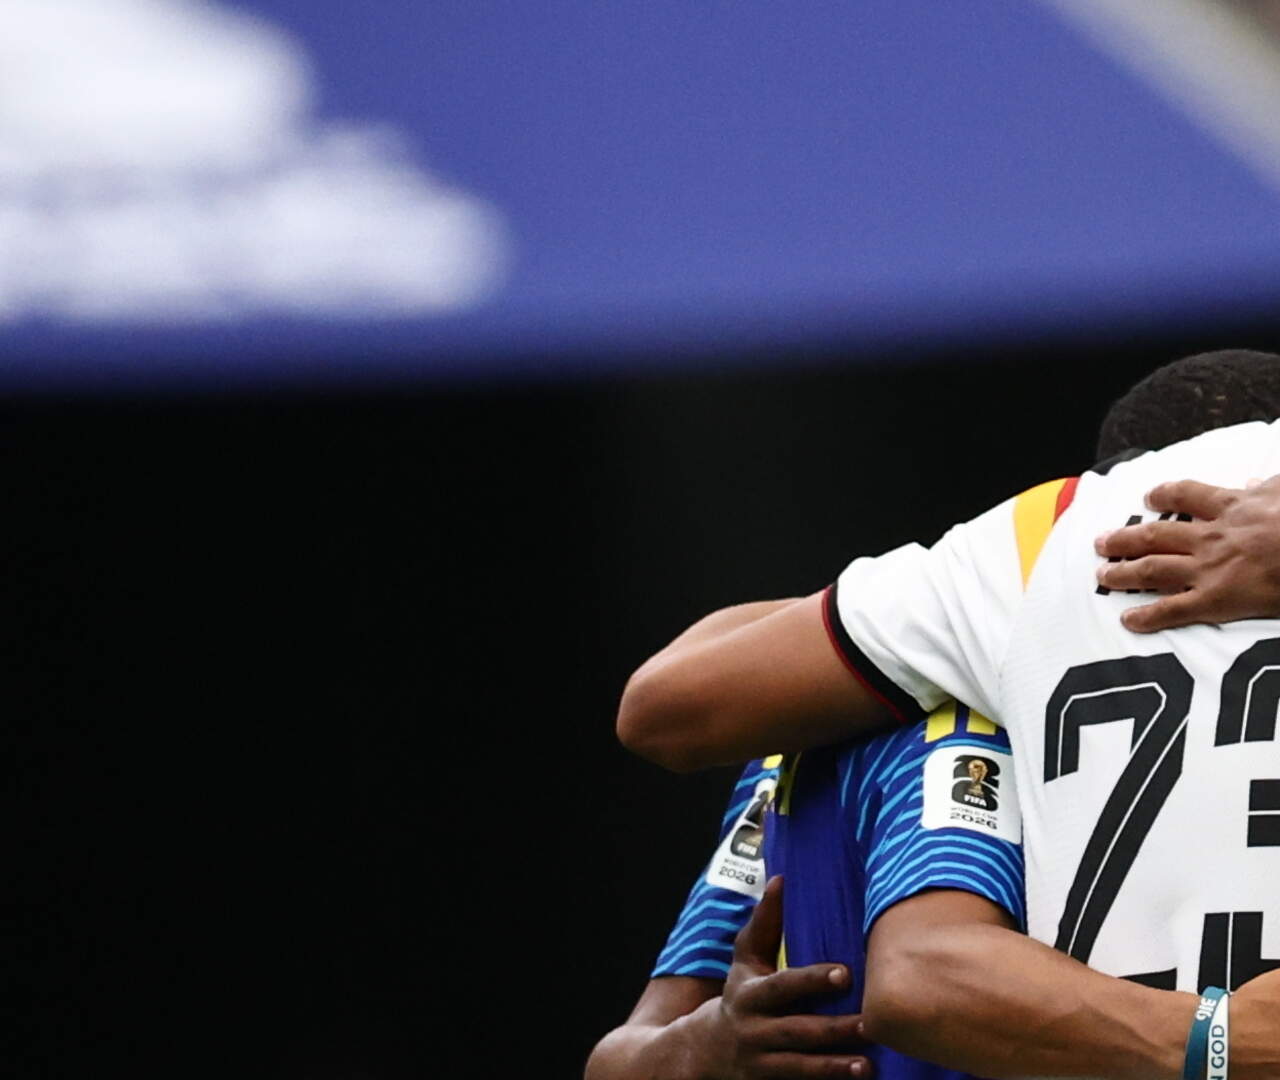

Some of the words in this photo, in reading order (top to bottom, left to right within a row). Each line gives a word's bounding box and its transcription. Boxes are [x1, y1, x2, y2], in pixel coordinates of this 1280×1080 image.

[964, 794, 987, 807] FIFA
[950, 813, 997, 830] 2026
[719, 866, 757, 886] 2026
[1211, 1025, 1225, 1069] GOD
